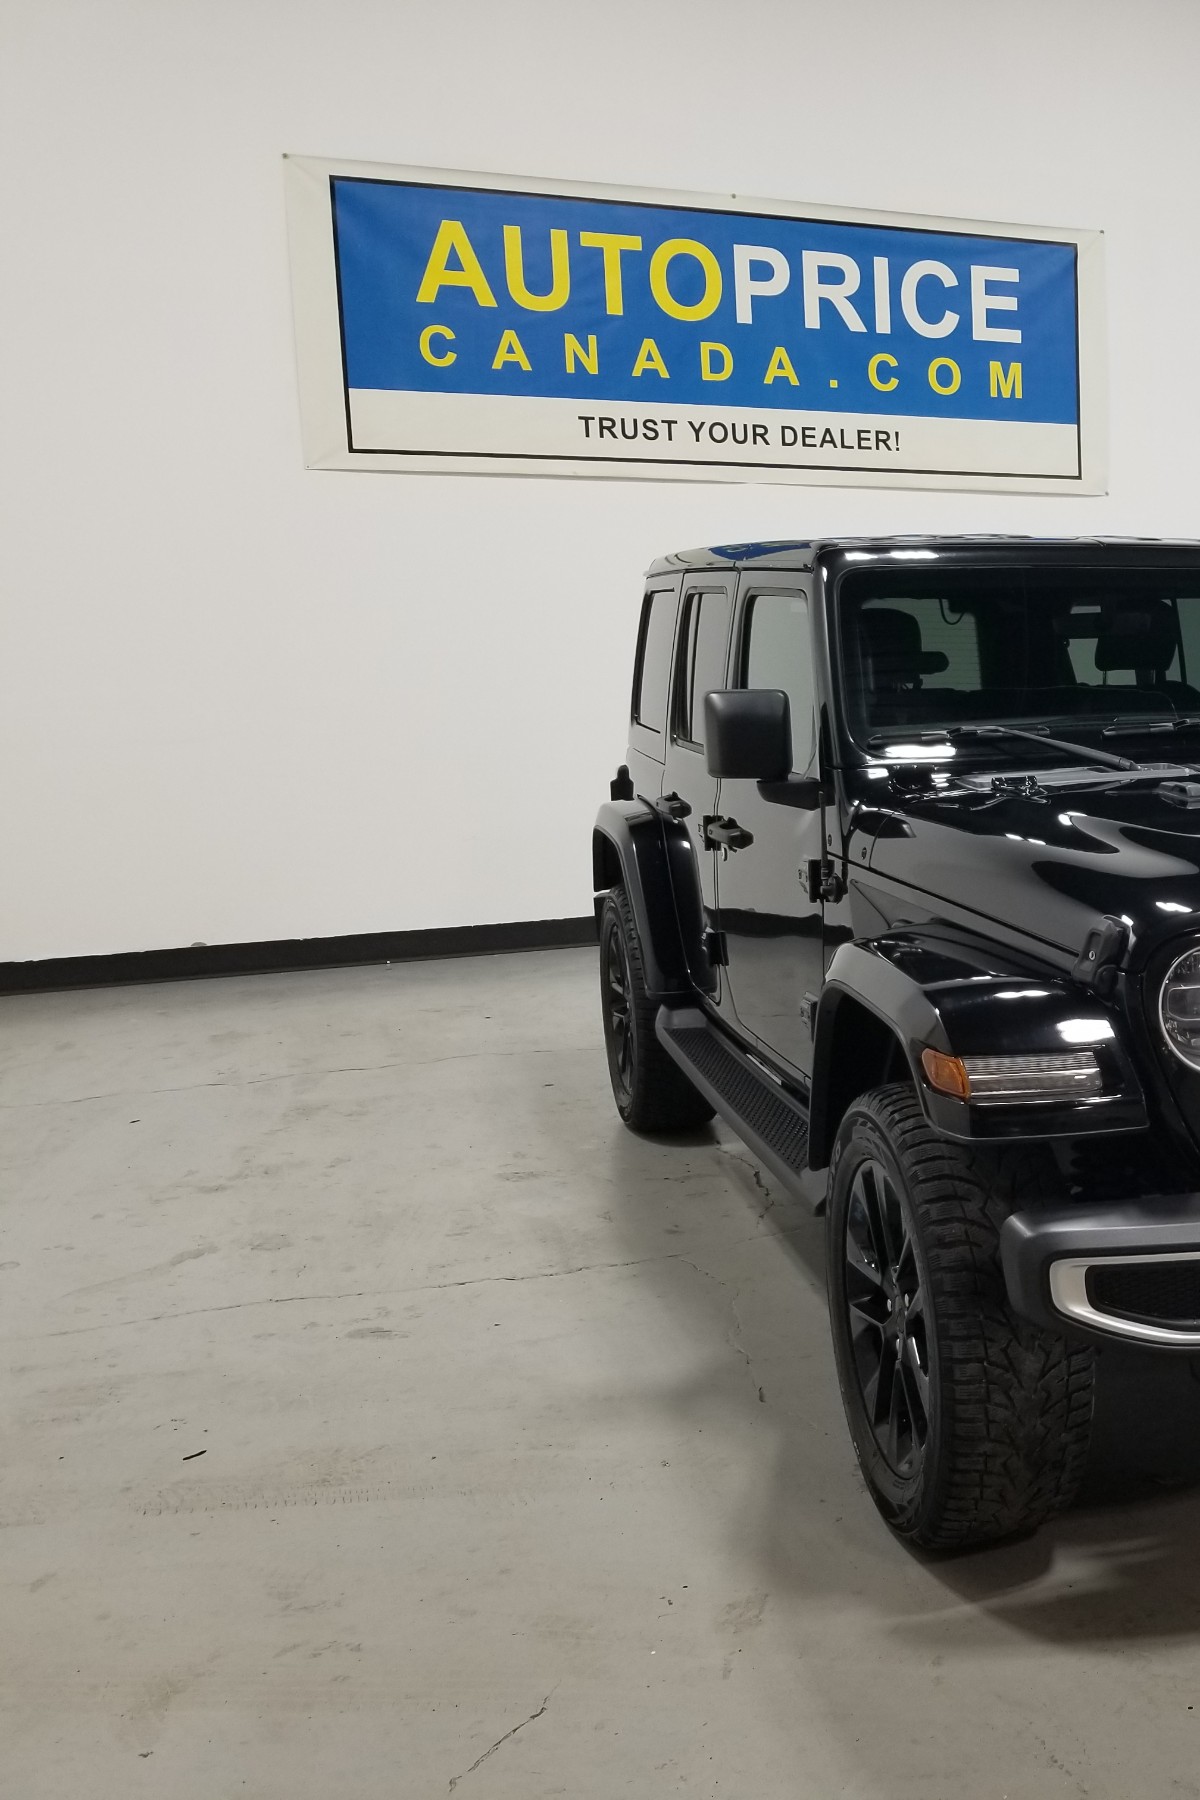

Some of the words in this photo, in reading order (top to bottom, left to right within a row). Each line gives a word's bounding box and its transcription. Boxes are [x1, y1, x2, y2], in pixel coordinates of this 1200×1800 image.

[416, 220, 1023, 344] AUTOPRICE
[419, 324, 1024, 399] CANADA.COM
[577, 415, 679, 443] TRUST
[687, 420, 772, 447] YOUR
[780, 425, 901, 453] DEALER!
